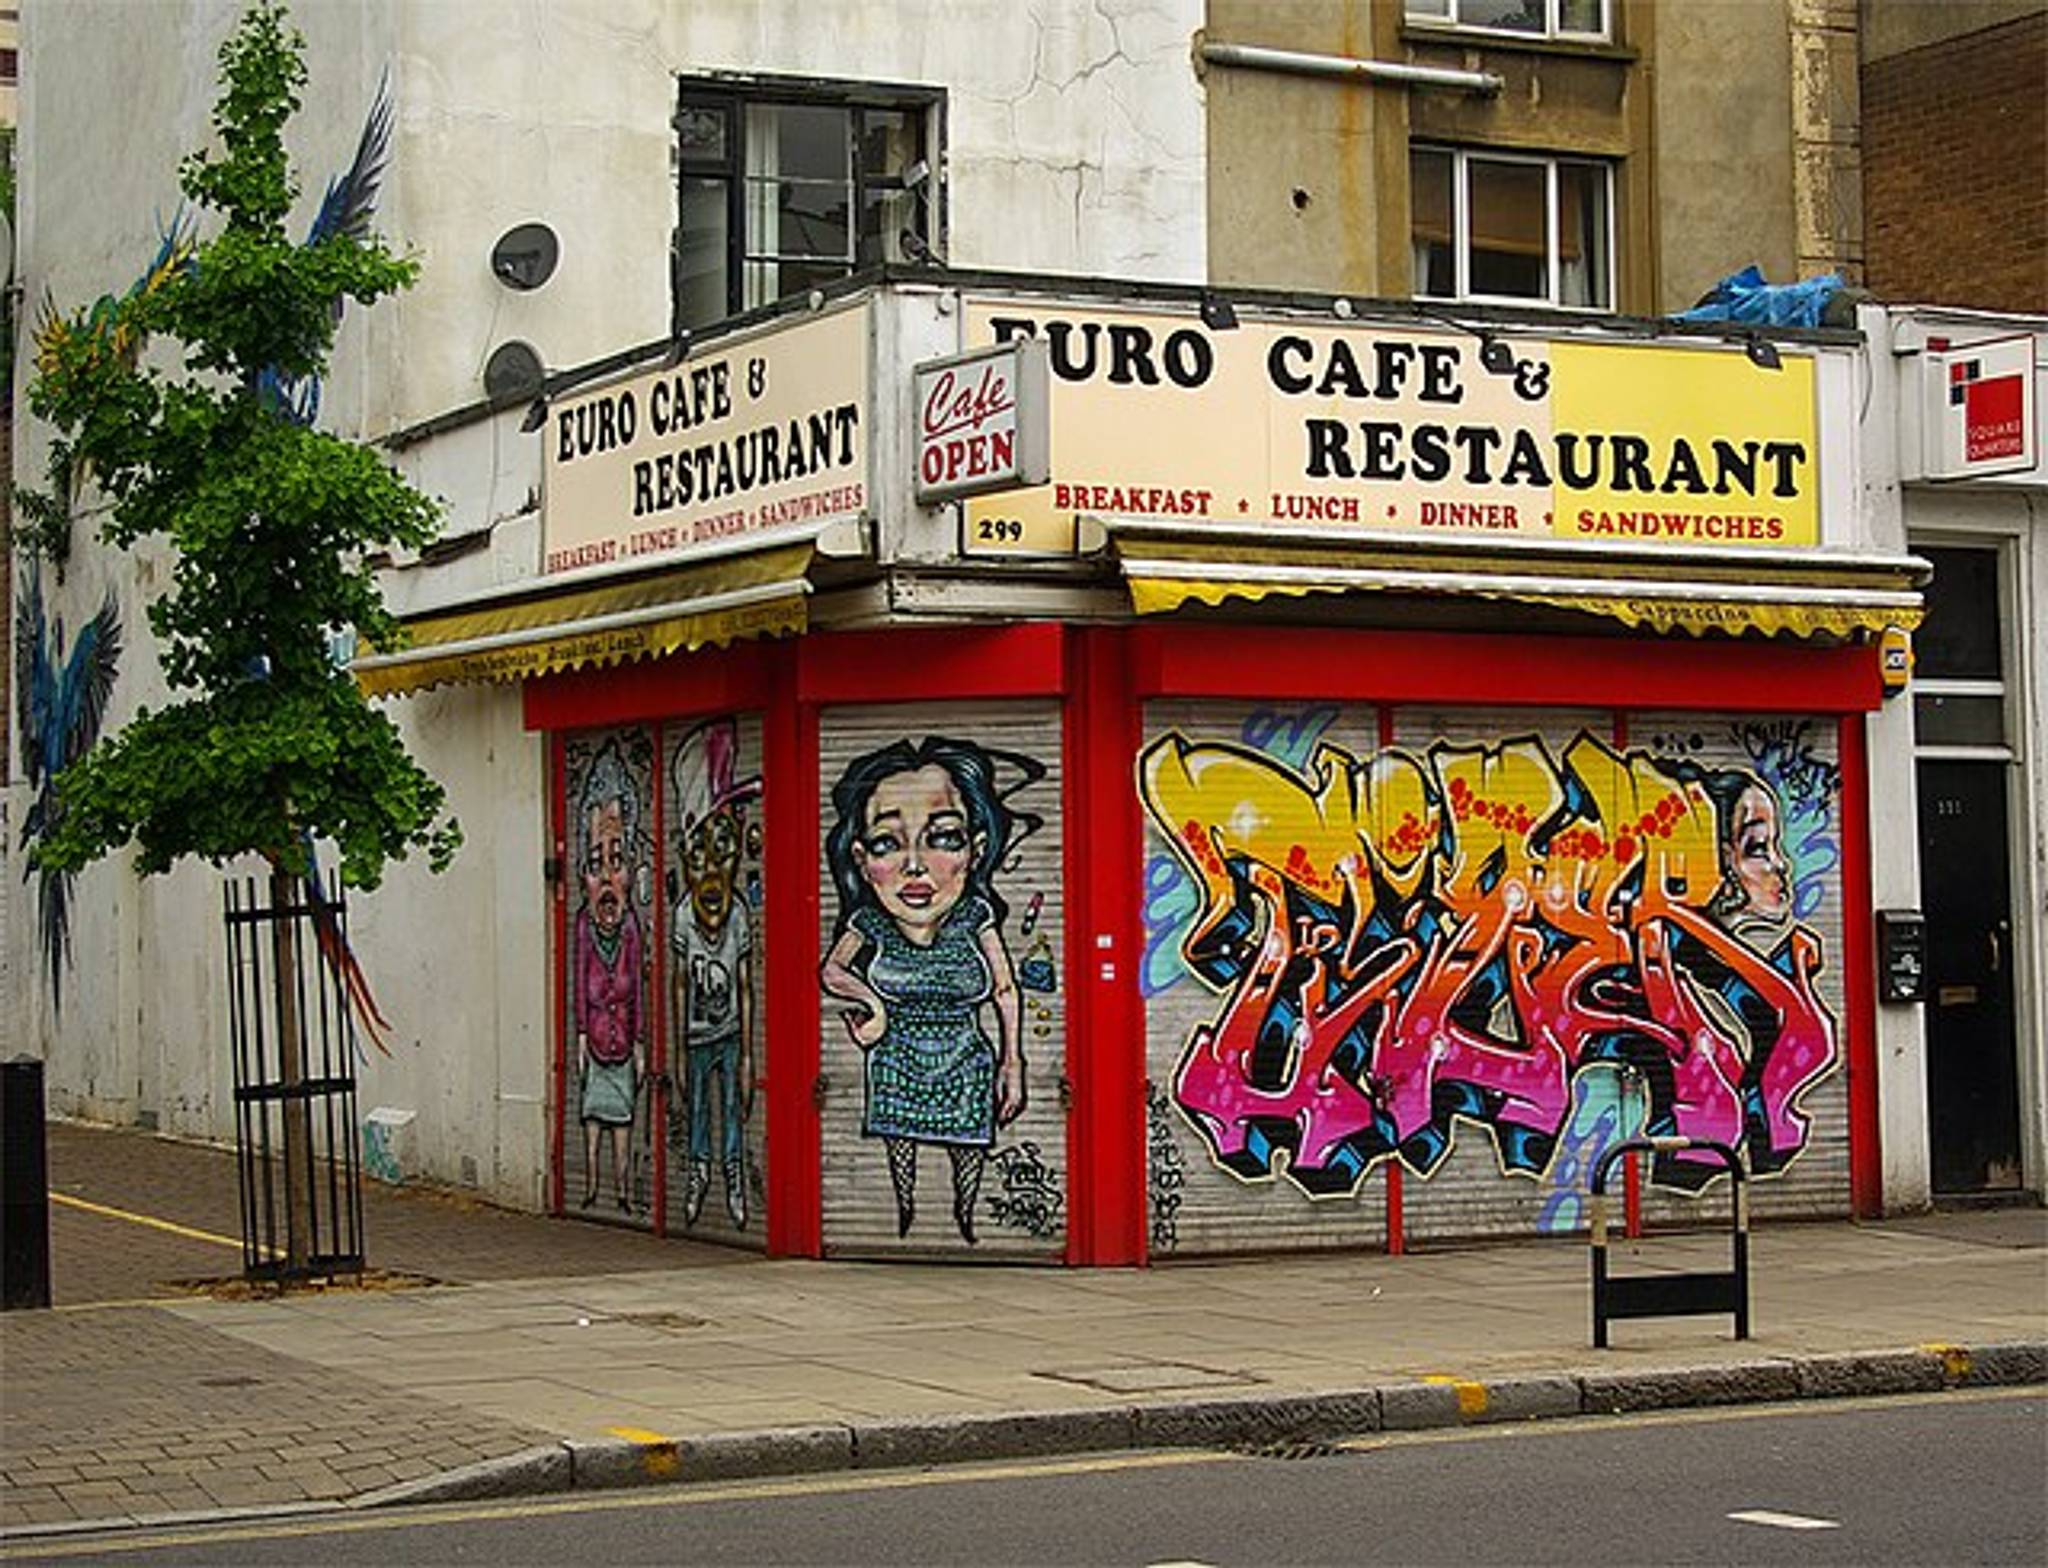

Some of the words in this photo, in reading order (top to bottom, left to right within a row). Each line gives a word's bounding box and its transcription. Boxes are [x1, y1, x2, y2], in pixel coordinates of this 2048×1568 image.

[924, 366, 1008, 434] Cafe
[1267, 335, 1463, 404] CAFE
[1512, 359, 1550, 401] &
[557, 391, 636, 462] EURO
[650, 360, 731, 436] CAFE
[748, 358, 766, 399] &
[633, 403, 859, 516] RESTAURANT
[923, 429, 1015, 484] OPEN
[1304, 419, 1806, 498] RESTAURANT
[547, 540, 616, 574] BREAKFAST
[630, 526, 677, 557] LUNCH
[694, 510, 744, 543] DINNER
[759, 484, 864, 526] SANDWICHES
[979, 519, 1022, 541] 299
[1054, 484, 1211, 514] BREAKFAST
[1271, 494, 1360, 522] LUNCH
[1420, 501, 1519, 529] DINNER
[1577, 510, 1784, 540] SANDWICHES
